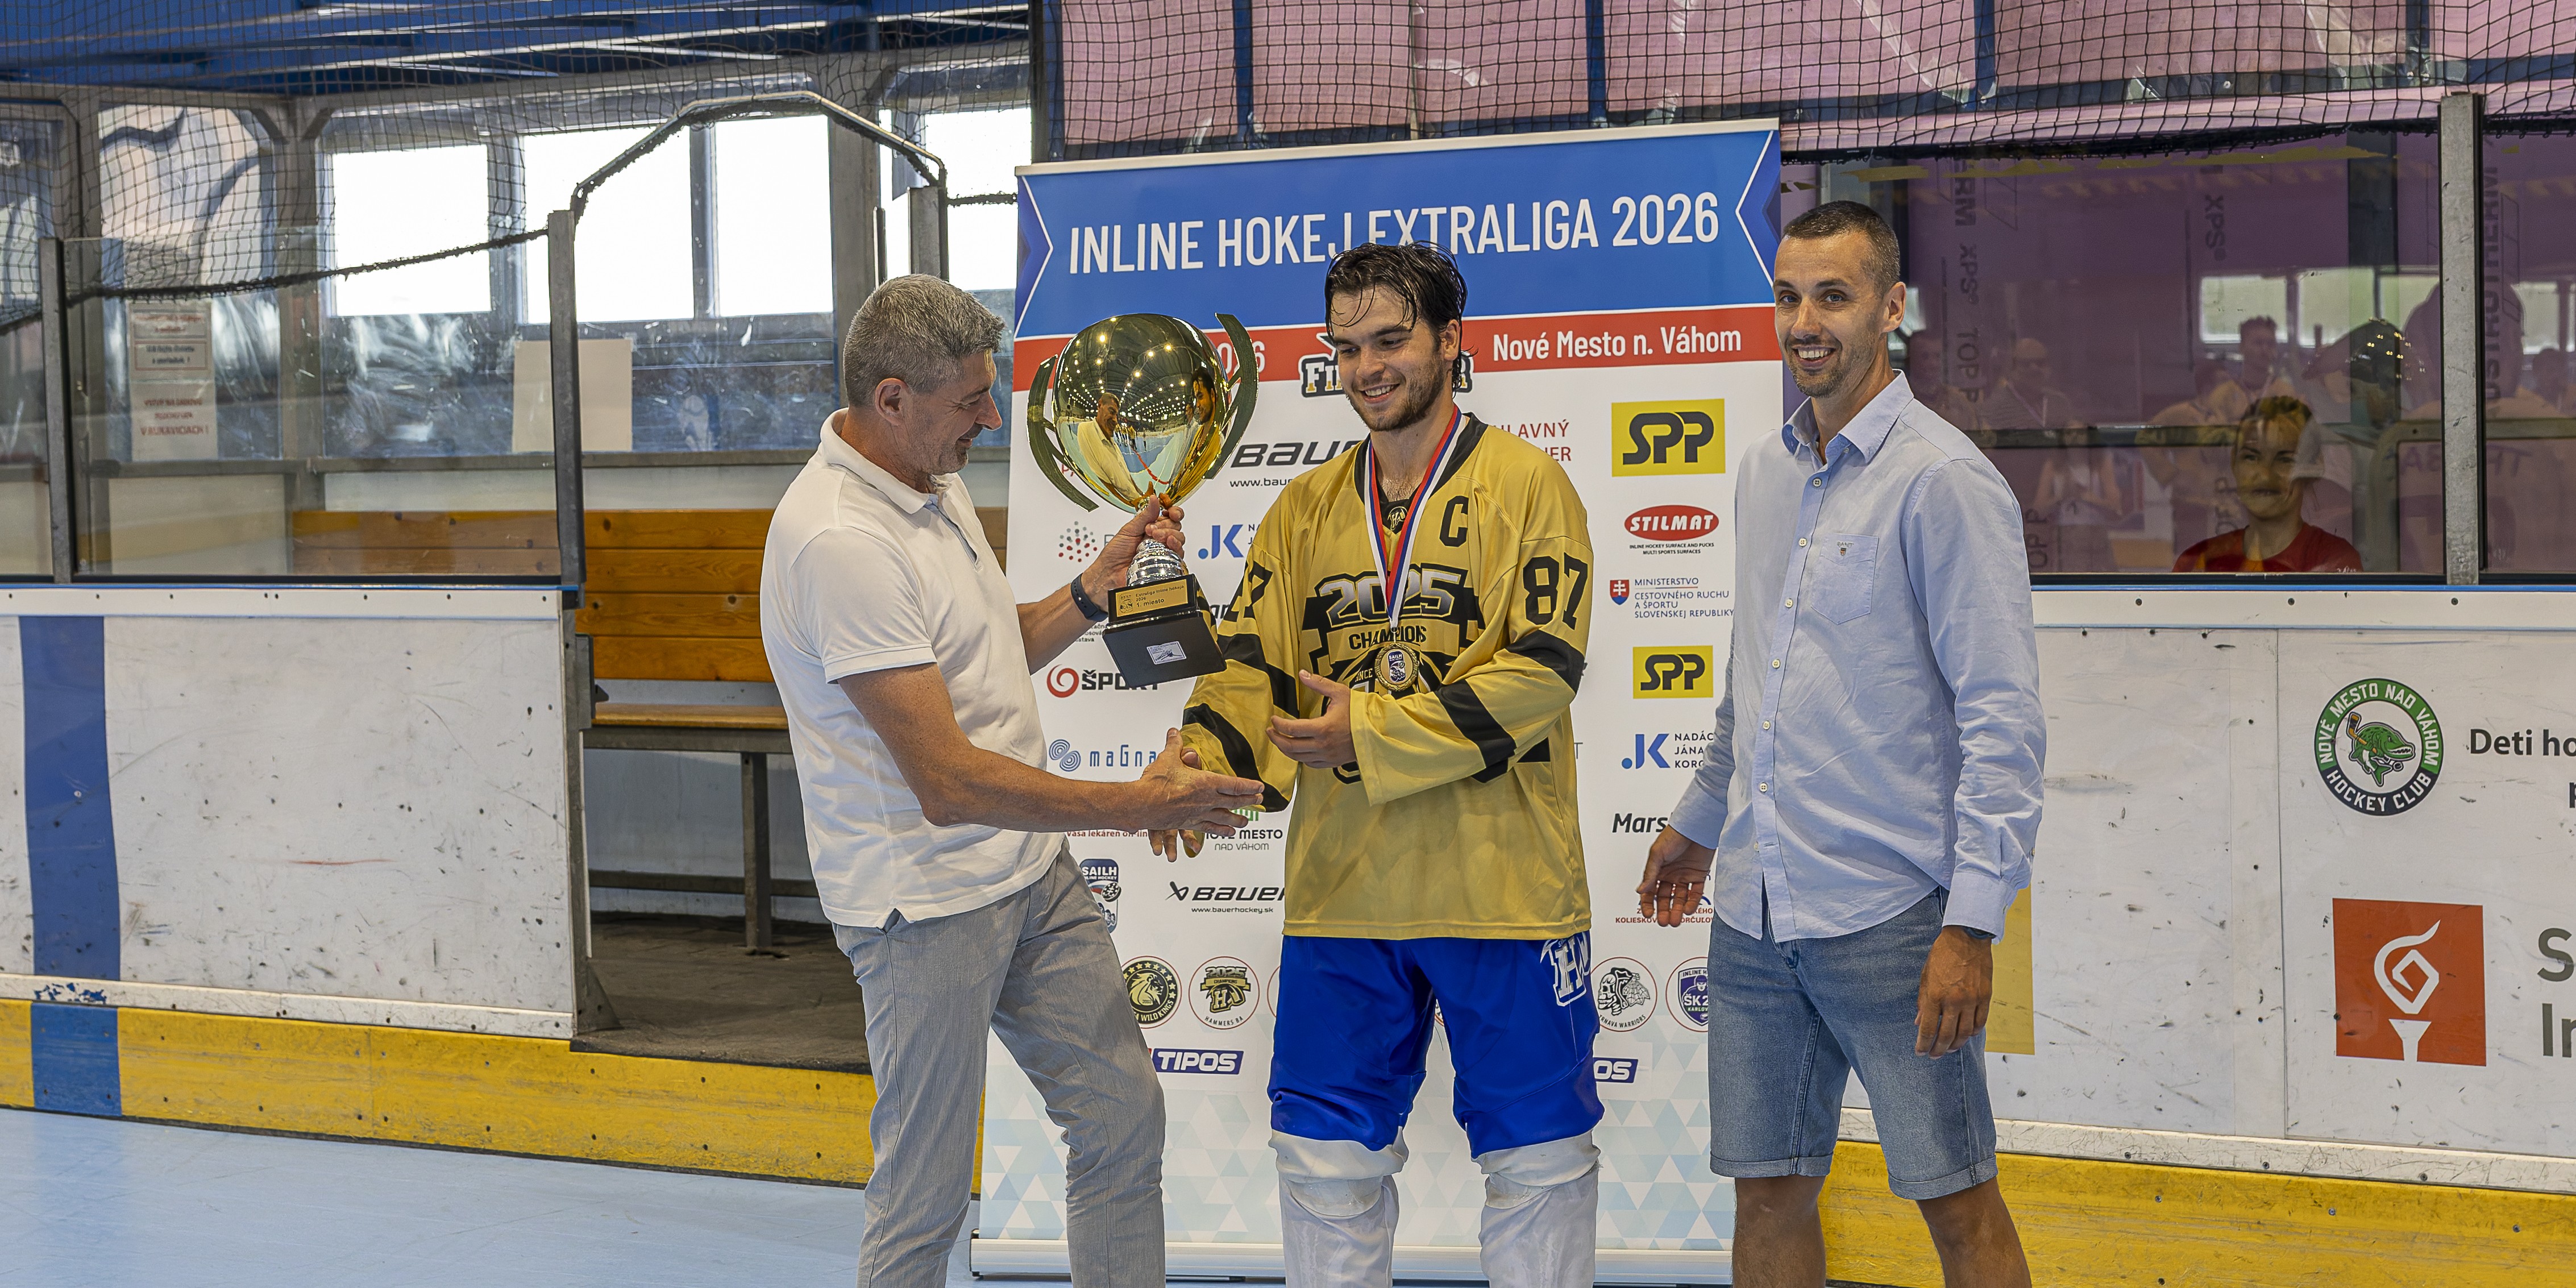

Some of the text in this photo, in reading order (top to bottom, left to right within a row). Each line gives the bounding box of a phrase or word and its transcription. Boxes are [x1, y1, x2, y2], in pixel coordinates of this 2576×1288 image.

[1070, 192, 1718, 274] INLINE HOKEJ EXTRALIGA 2026
[1493, 326, 1742, 362] Nové Mesto n. Váhom
[1623, 411, 1714, 465] SPP
[1231, 441, 1364, 468] BAU
[1439, 496, 1469, 548] C
[1630, 514, 1714, 532] STILMAT
[1523, 552, 1590, 630] 87
[1635, 577, 1699, 586] MINISTERSTVO
[1143, 598, 1165, 606] miesto
[1319, 568, 1462, 628] 2025
[1635, 590, 1694, 600] CESTOVNÉHO
[1635, 609, 1734, 618] SLOVENSKEJ REPUBLIKY
[1640, 654, 1705, 691] SPP
[2318, 683, 2440, 766] NOVÉ MESTO NAD VÁHOM
[1675, 744, 1704, 755] JÁNA
[2470, 728, 2533, 756] Deti
[2326, 770, 2432, 812] HOCKEY CLUB
[1612, 812, 1673, 833] Mars
[1240, 829, 1283, 839] MESTO
[1236, 842, 1269, 850] VÁHOM
[1082, 867, 1117, 875] SAILH
[1206, 966, 1247, 978] 2025
[1140, 1012, 1158, 1021] WILD
[1157, 999, 1174, 1017] KINGS
[1204, 1016, 1234, 1027] HAMMERS
[1619, 1015, 1647, 1028] WARRIORS
[1158, 1051, 1237, 1072] TIPOS
